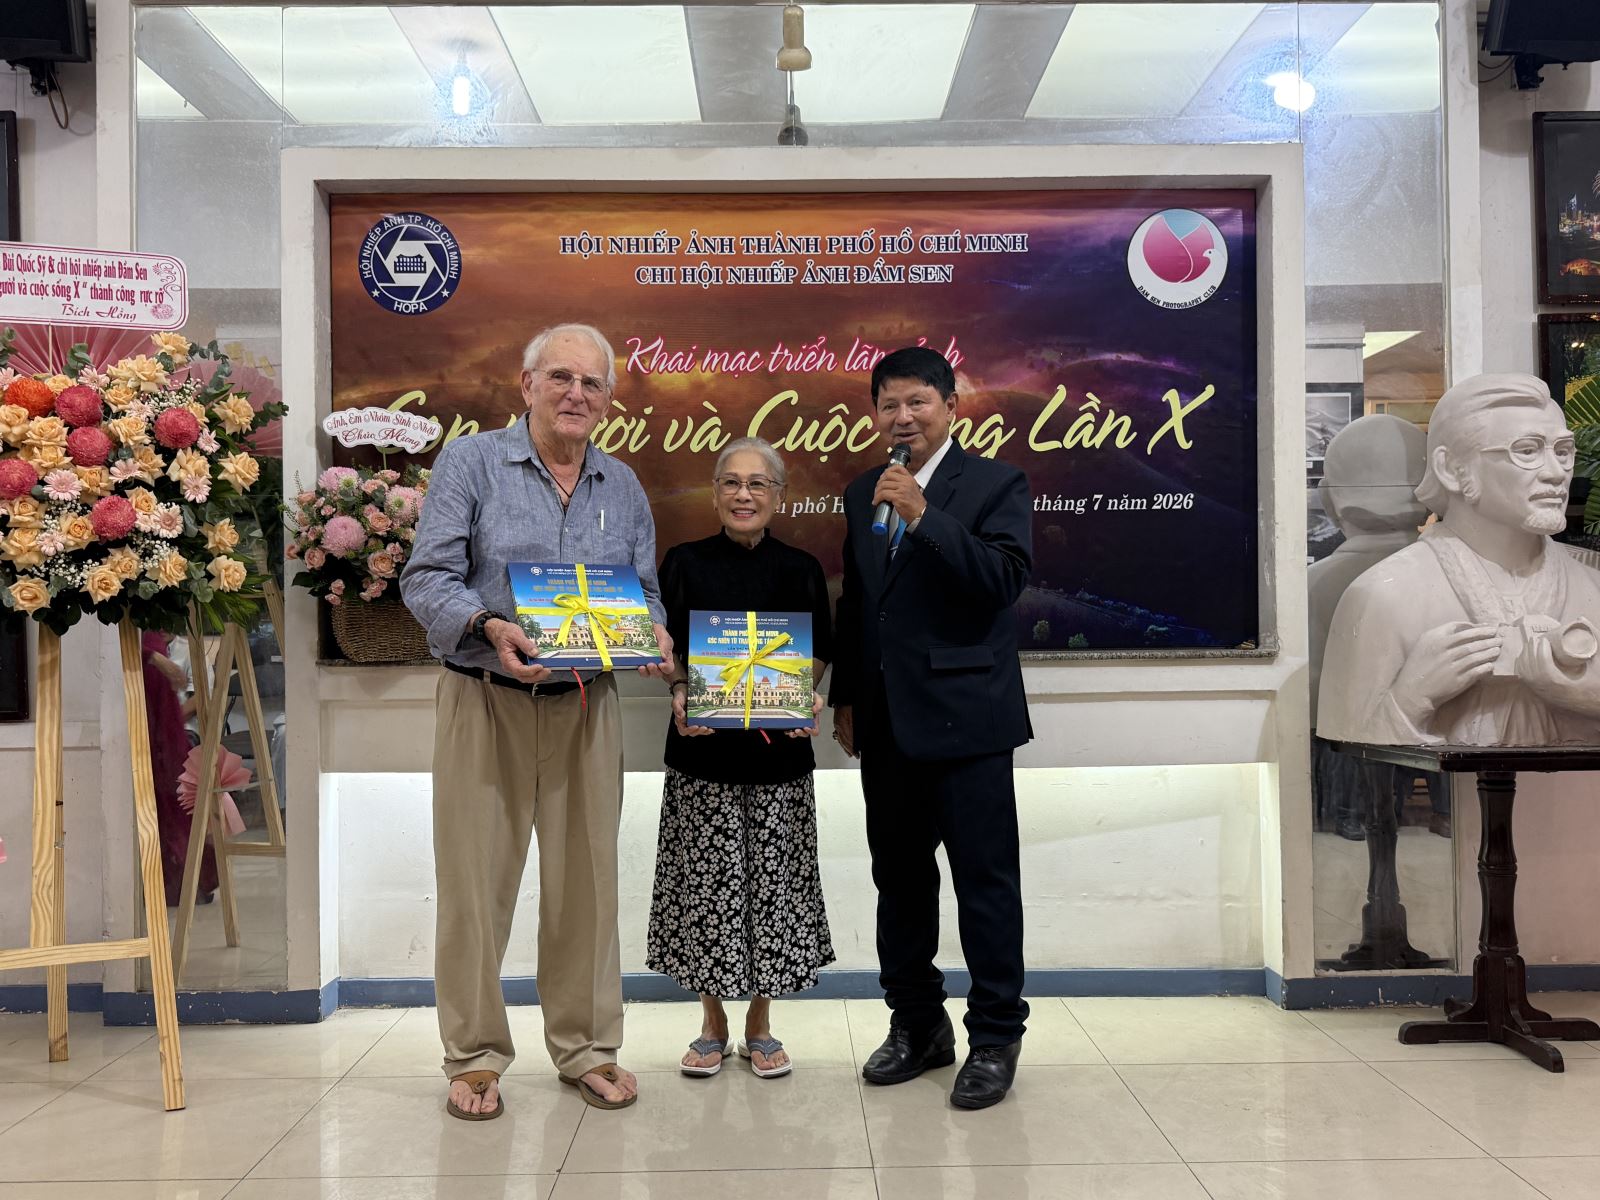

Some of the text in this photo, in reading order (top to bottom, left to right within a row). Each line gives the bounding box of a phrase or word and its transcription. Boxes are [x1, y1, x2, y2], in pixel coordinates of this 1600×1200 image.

[559, 227, 1028, 259] HỘI NHIẾP ẢNH THÀNH PHỐ HỒ CHÍ MINH
[2, 252, 15, 272] Bùi
[16, 253, 36, 275] Quốc
[48, 255, 55, 274] &
[82, 258, 102, 281] nhiếp
[134, 261, 148, 281] Sen
[448, 251, 459, 280] MINH
[634, 257, 954, 289] CHI HỘI NHIẾP ẢNH ĐẦM SEN
[17, 278, 28, 296] và
[29, 279, 50, 301] cuộc
[51, 278, 72, 302] sống
[89, 282, 114, 301] thành
[115, 284, 136, 306] công
[1137, 284, 1217, 309] DAM SEN PHOTOGRAPHY CLUB
[61, 303, 137, 322] Bích Hồng
[393, 301, 428, 314] HOPA
[625, 336, 695, 374] Khai
[700, 350, 764, 379] mạc
[767, 336, 837, 374] triển
[341, 427, 376, 443] Chúc
[662, 400, 731, 453] và
[747, 389, 880, 463] Cuộc
[1028, 384, 1138, 453] Lần
[1146, 383, 1216, 455] X
[791, 494, 831, 518] phố
[1032, 494, 1088, 515] tháng
[1092, 493, 1104, 511] 7
[1106, 493, 1147, 511] năm
[1151, 492, 1195, 510] 2026
